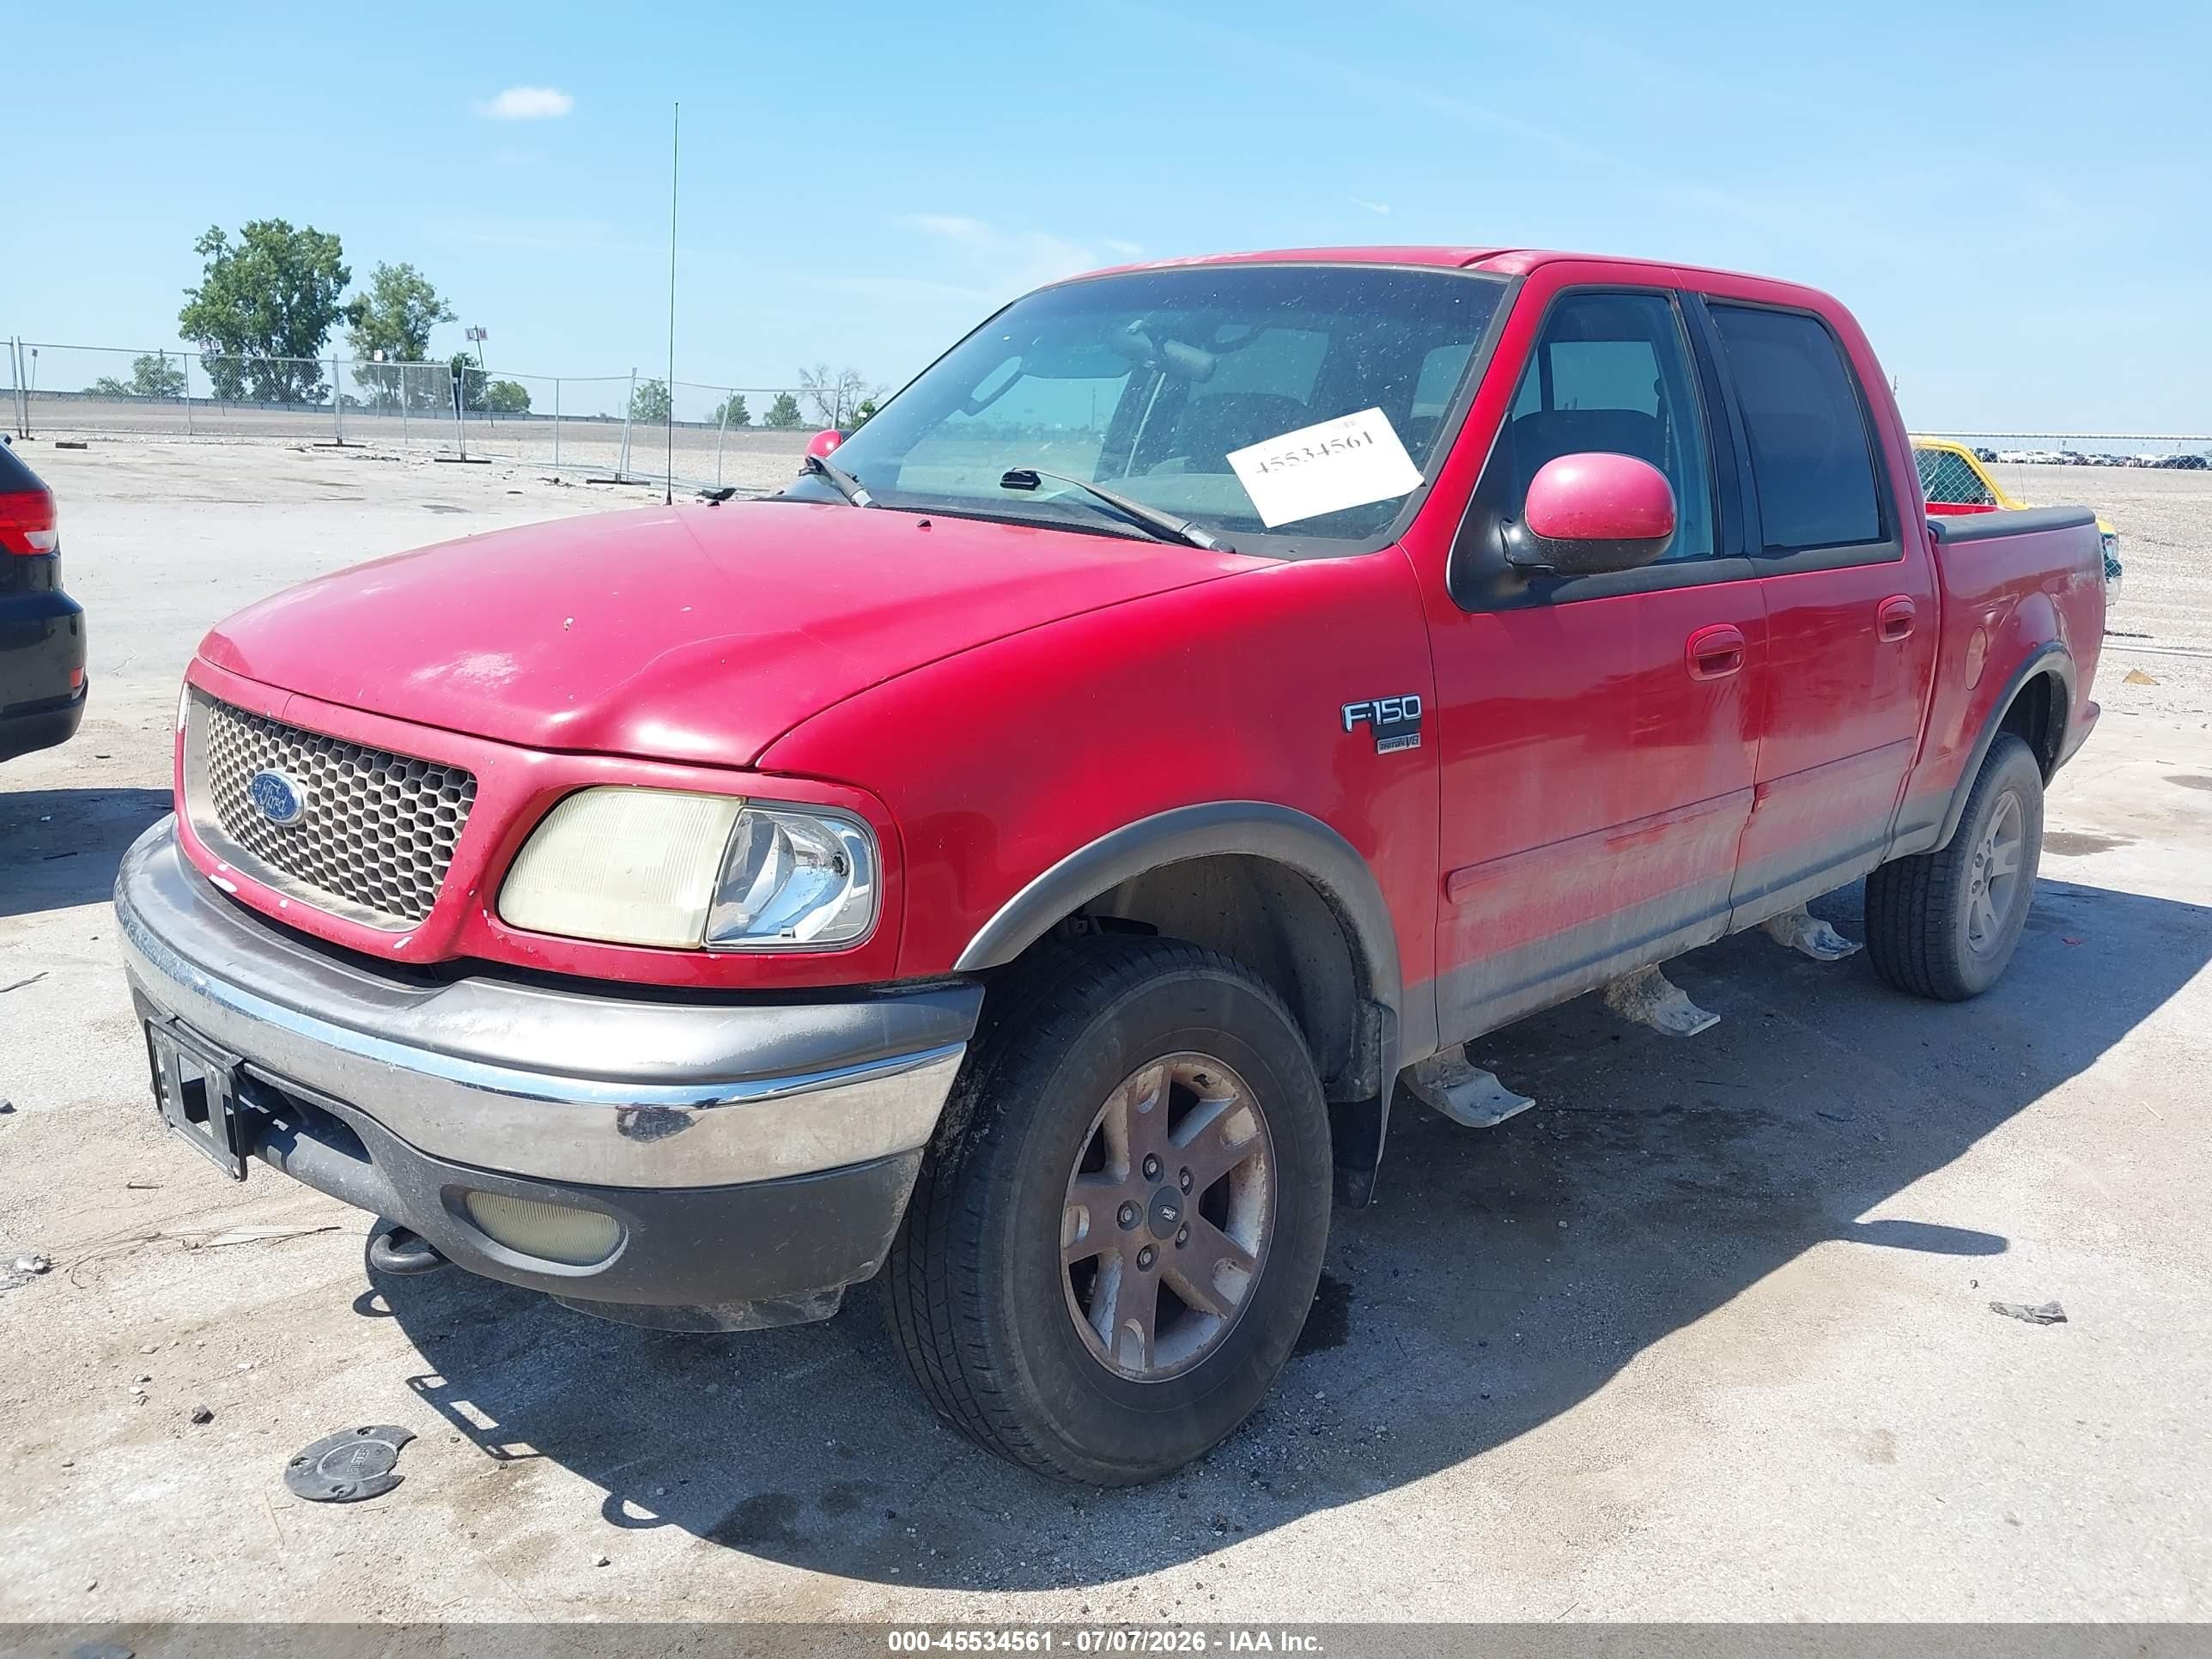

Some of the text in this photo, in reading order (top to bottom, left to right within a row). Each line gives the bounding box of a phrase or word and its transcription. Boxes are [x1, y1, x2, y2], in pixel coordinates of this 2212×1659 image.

[1256, 430, 1374, 473] 45534561
[1380, 735, 1419, 750] TRITON V8
